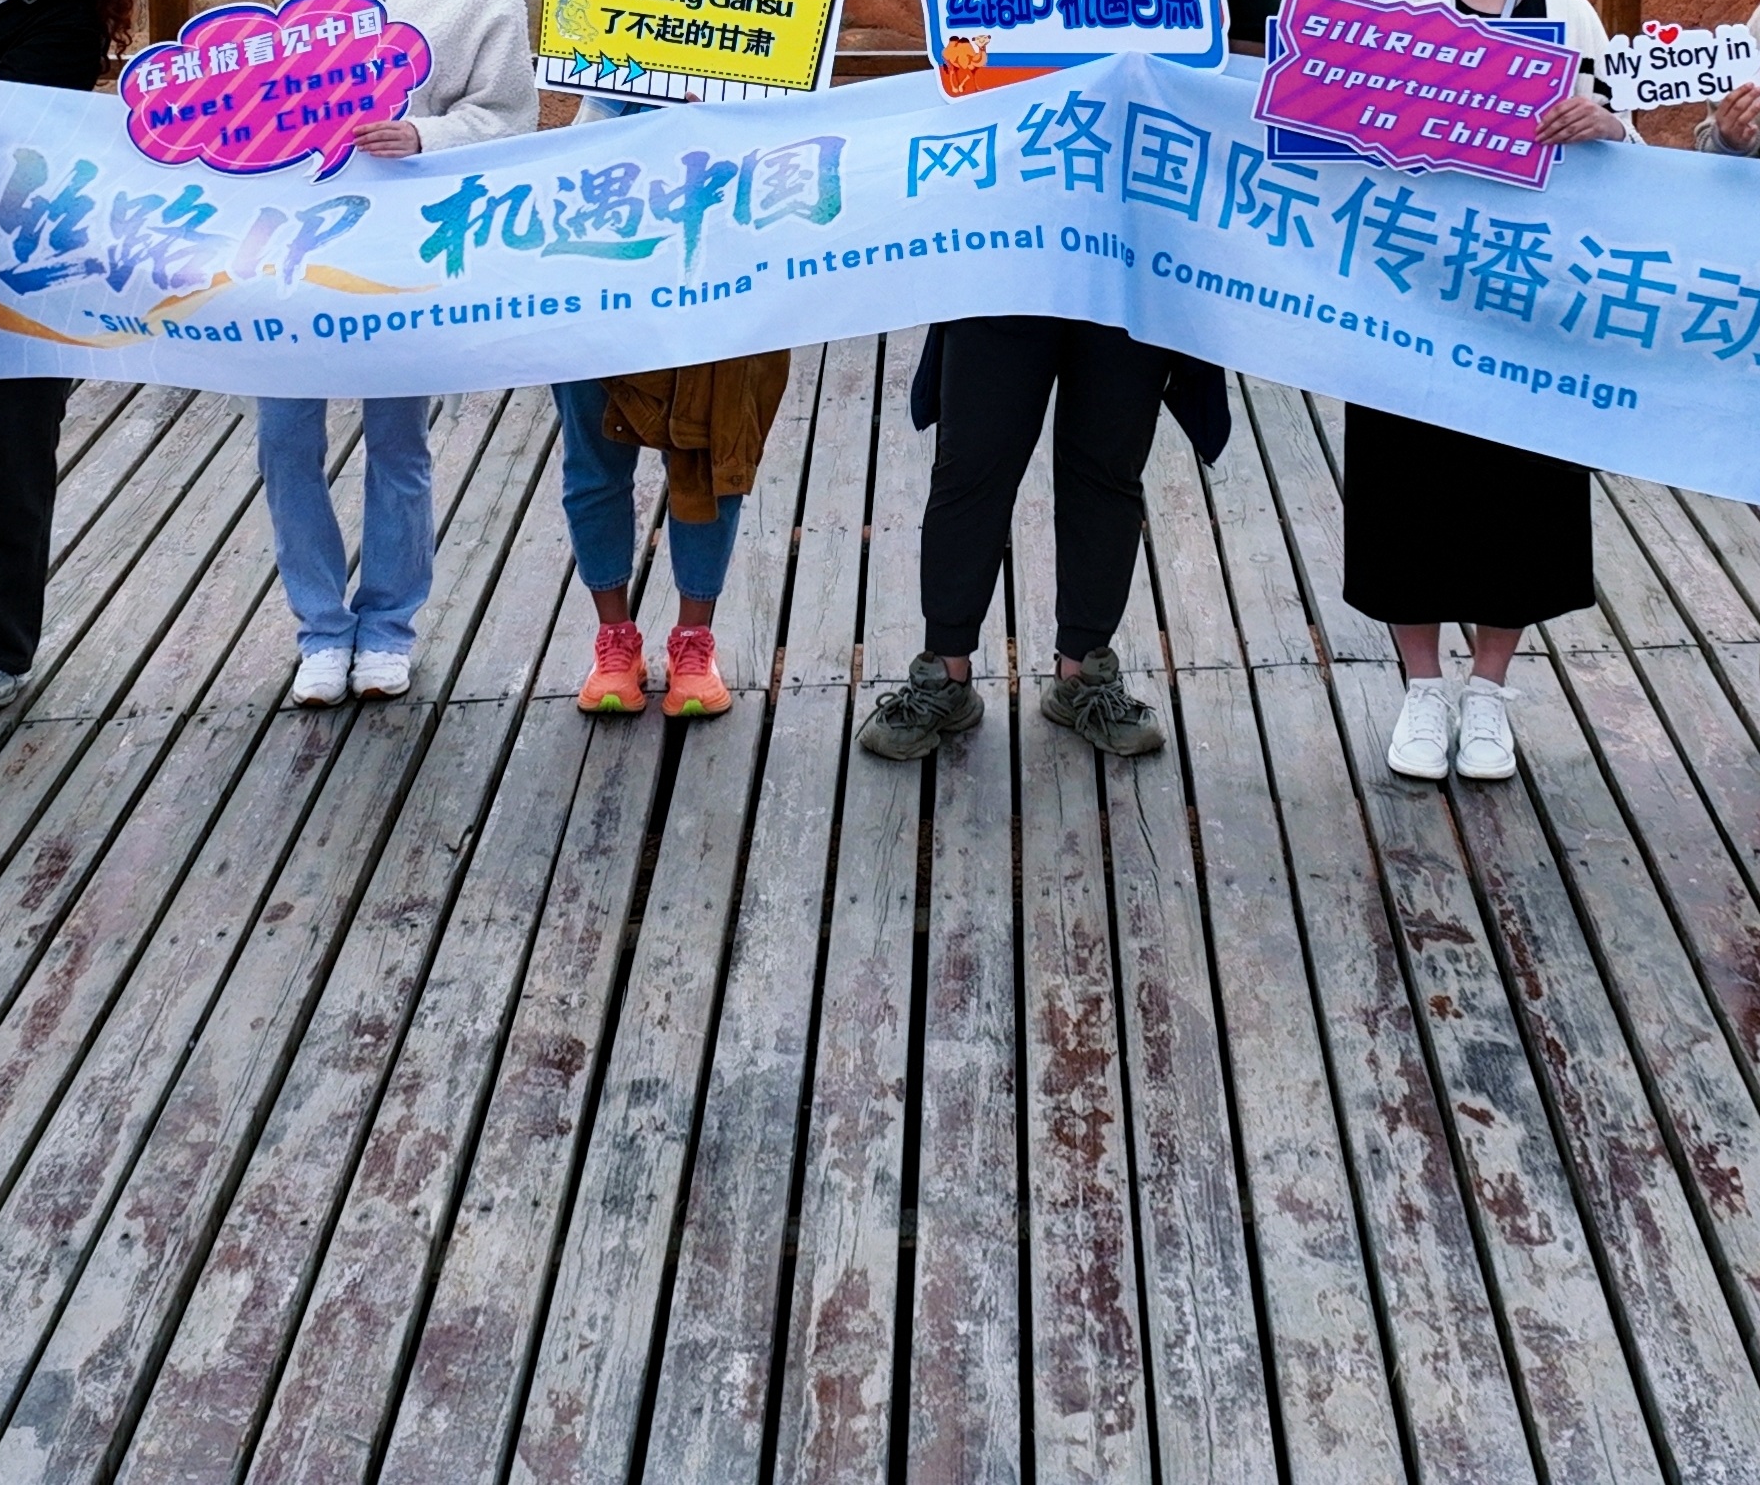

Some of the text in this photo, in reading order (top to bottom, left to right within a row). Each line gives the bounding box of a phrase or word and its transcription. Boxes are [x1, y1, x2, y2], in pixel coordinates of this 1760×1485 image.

[135, 6, 383, 93] 在张掖看见中国
[600, 7, 776, 58] 了不起的甘肃
[1300, 14, 1563, 88] SilkRoad IP,
[1604, 37, 1752, 78] My Story in
[149, 50, 410, 130] Meet Zhangye
[1301, 58, 1536, 118] Opportunities
[1637, 73, 1733, 103] Gan Su
[219, 92, 375, 147] in China
[1358, 105, 1534, 157] in China
[419, 135, 846, 279] 机遇中国
[161, 318, 243, 342] Road
[252, 317, 299, 344] IP,
[311, 294, 582, 344] Opportunities
[600, 287, 633, 312] in
[786, 225, 1044, 281] International
[1151, 251, 1435, 357] Communication
[1450, 343, 1639, 411] Campaign
